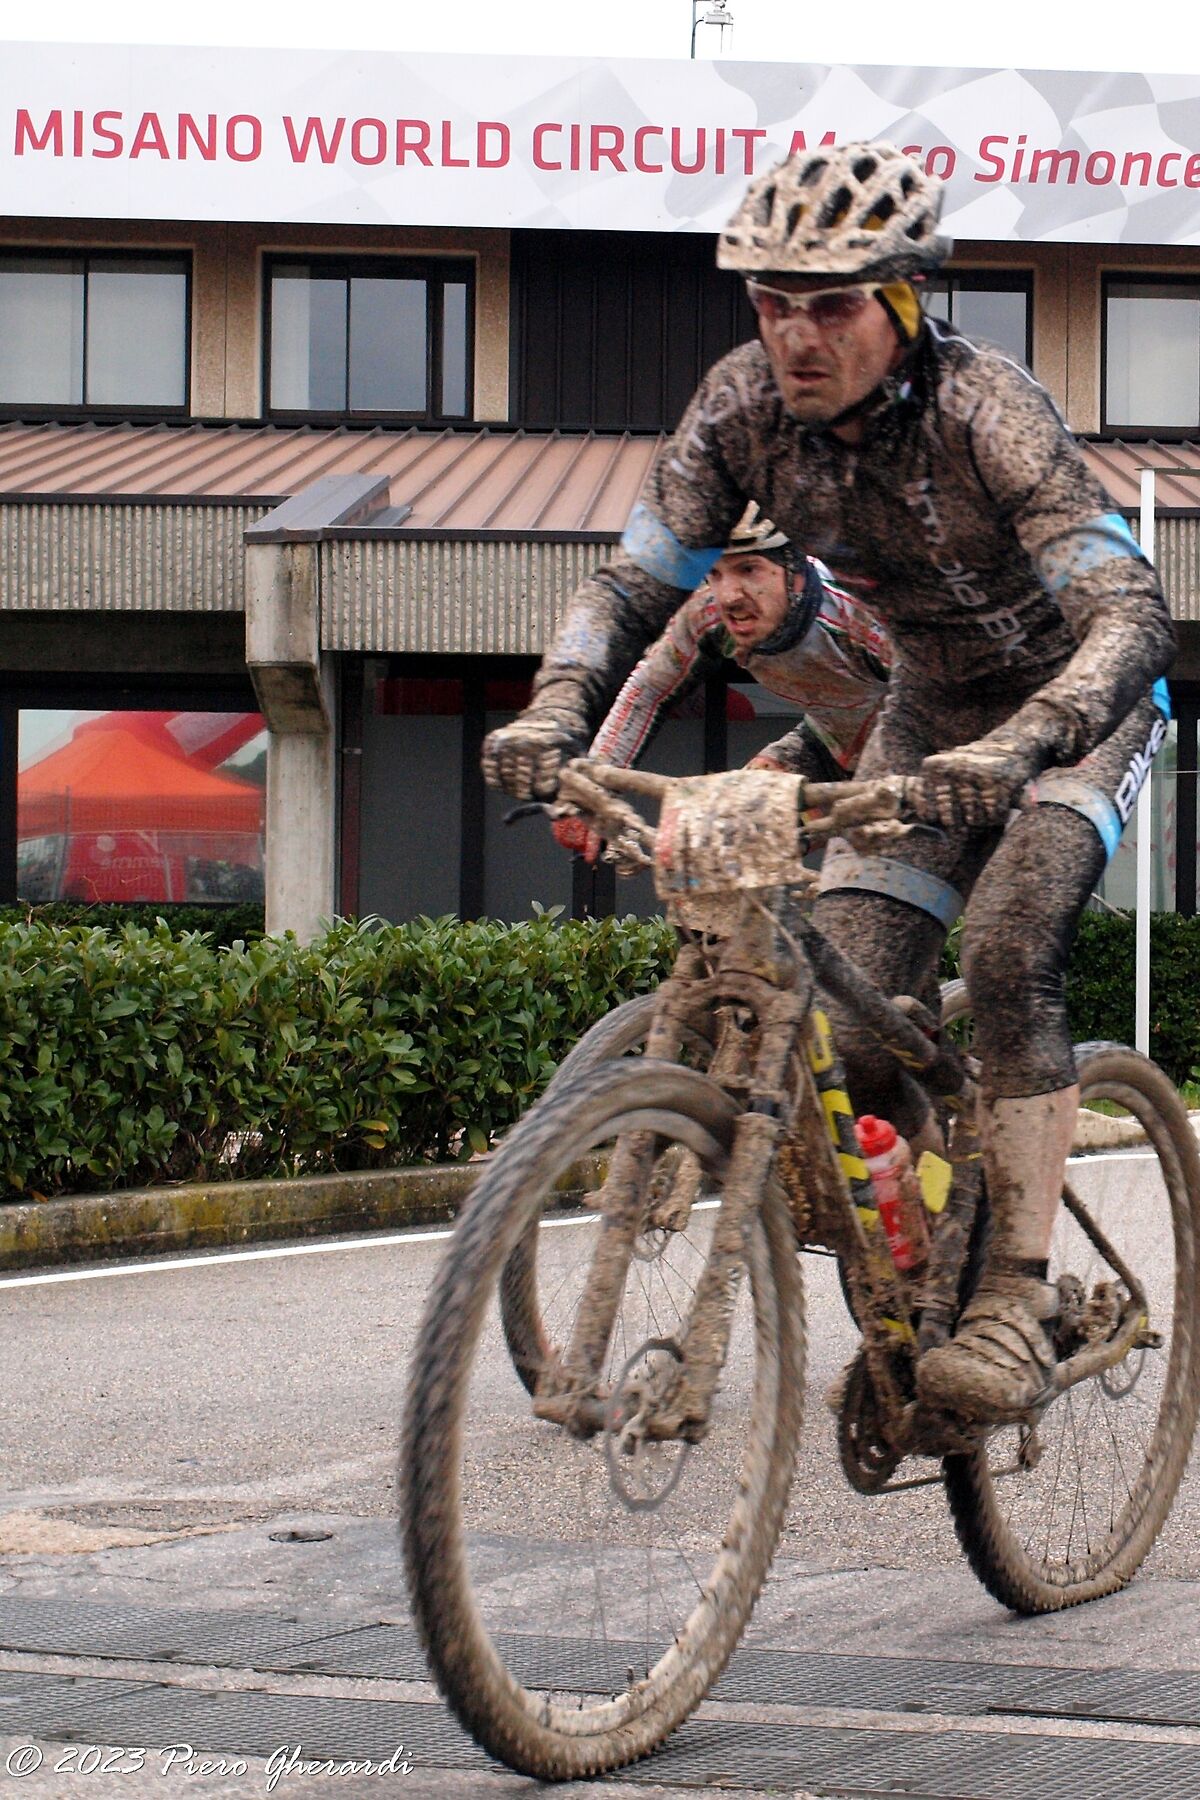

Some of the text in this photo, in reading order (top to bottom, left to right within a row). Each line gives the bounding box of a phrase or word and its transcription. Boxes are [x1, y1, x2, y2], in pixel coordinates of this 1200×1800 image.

[14, 109, 262, 162] MISANO
[283, 115, 511, 169] WORLD
[532, 122, 767, 175] CIRCUIT
